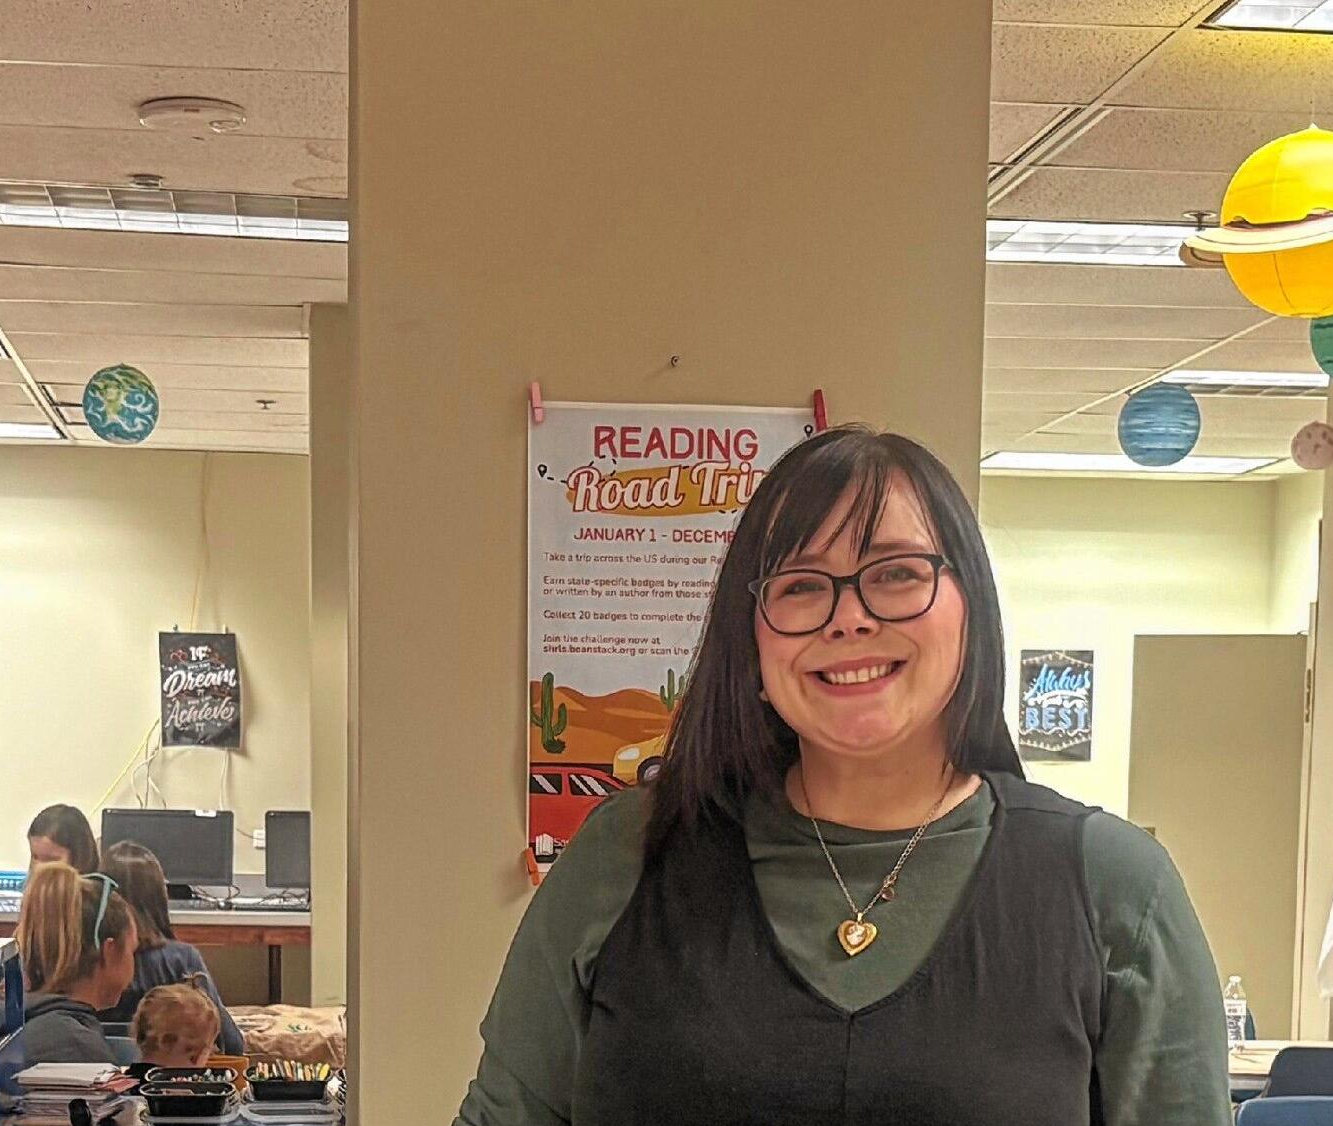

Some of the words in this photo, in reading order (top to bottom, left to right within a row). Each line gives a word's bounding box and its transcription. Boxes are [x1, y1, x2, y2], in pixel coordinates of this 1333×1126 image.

[594, 425, 759, 460] READING
[568, 464, 685, 512] Road
[690, 460, 765, 507] Tri
[574, 527, 645, 542] JANUARY
[649, 528, 656, 541] 1
[543, 551, 566, 561] Take
[626, 554, 641, 563] the
[644, 554, 658, 563] US
[660, 555, 689, 565] during
[543, 575, 565, 585] Earn
[631, 578, 665, 588] badges
[667, 579, 679, 588] by
[555, 588, 589, 596] written
[591, 588, 602, 597] by
[619, 589, 648, 597] author
[651, 590, 674, 598] from
[675, 590, 701, 599] those
[543, 609, 576, 620] Collect
[579, 611, 591, 620] 20
[593, 612, 627, 621] badges
[641, 613, 683, 622] complete
[686, 613, 701, 622] the
[543, 634, 561, 643] Join
[563, 635, 579, 643] the
[580, 635, 626, 645] challenge
[650, 648, 671, 656] scan
[163, 668, 237, 698] Dream
[1025, 707, 1088, 730] BEST
